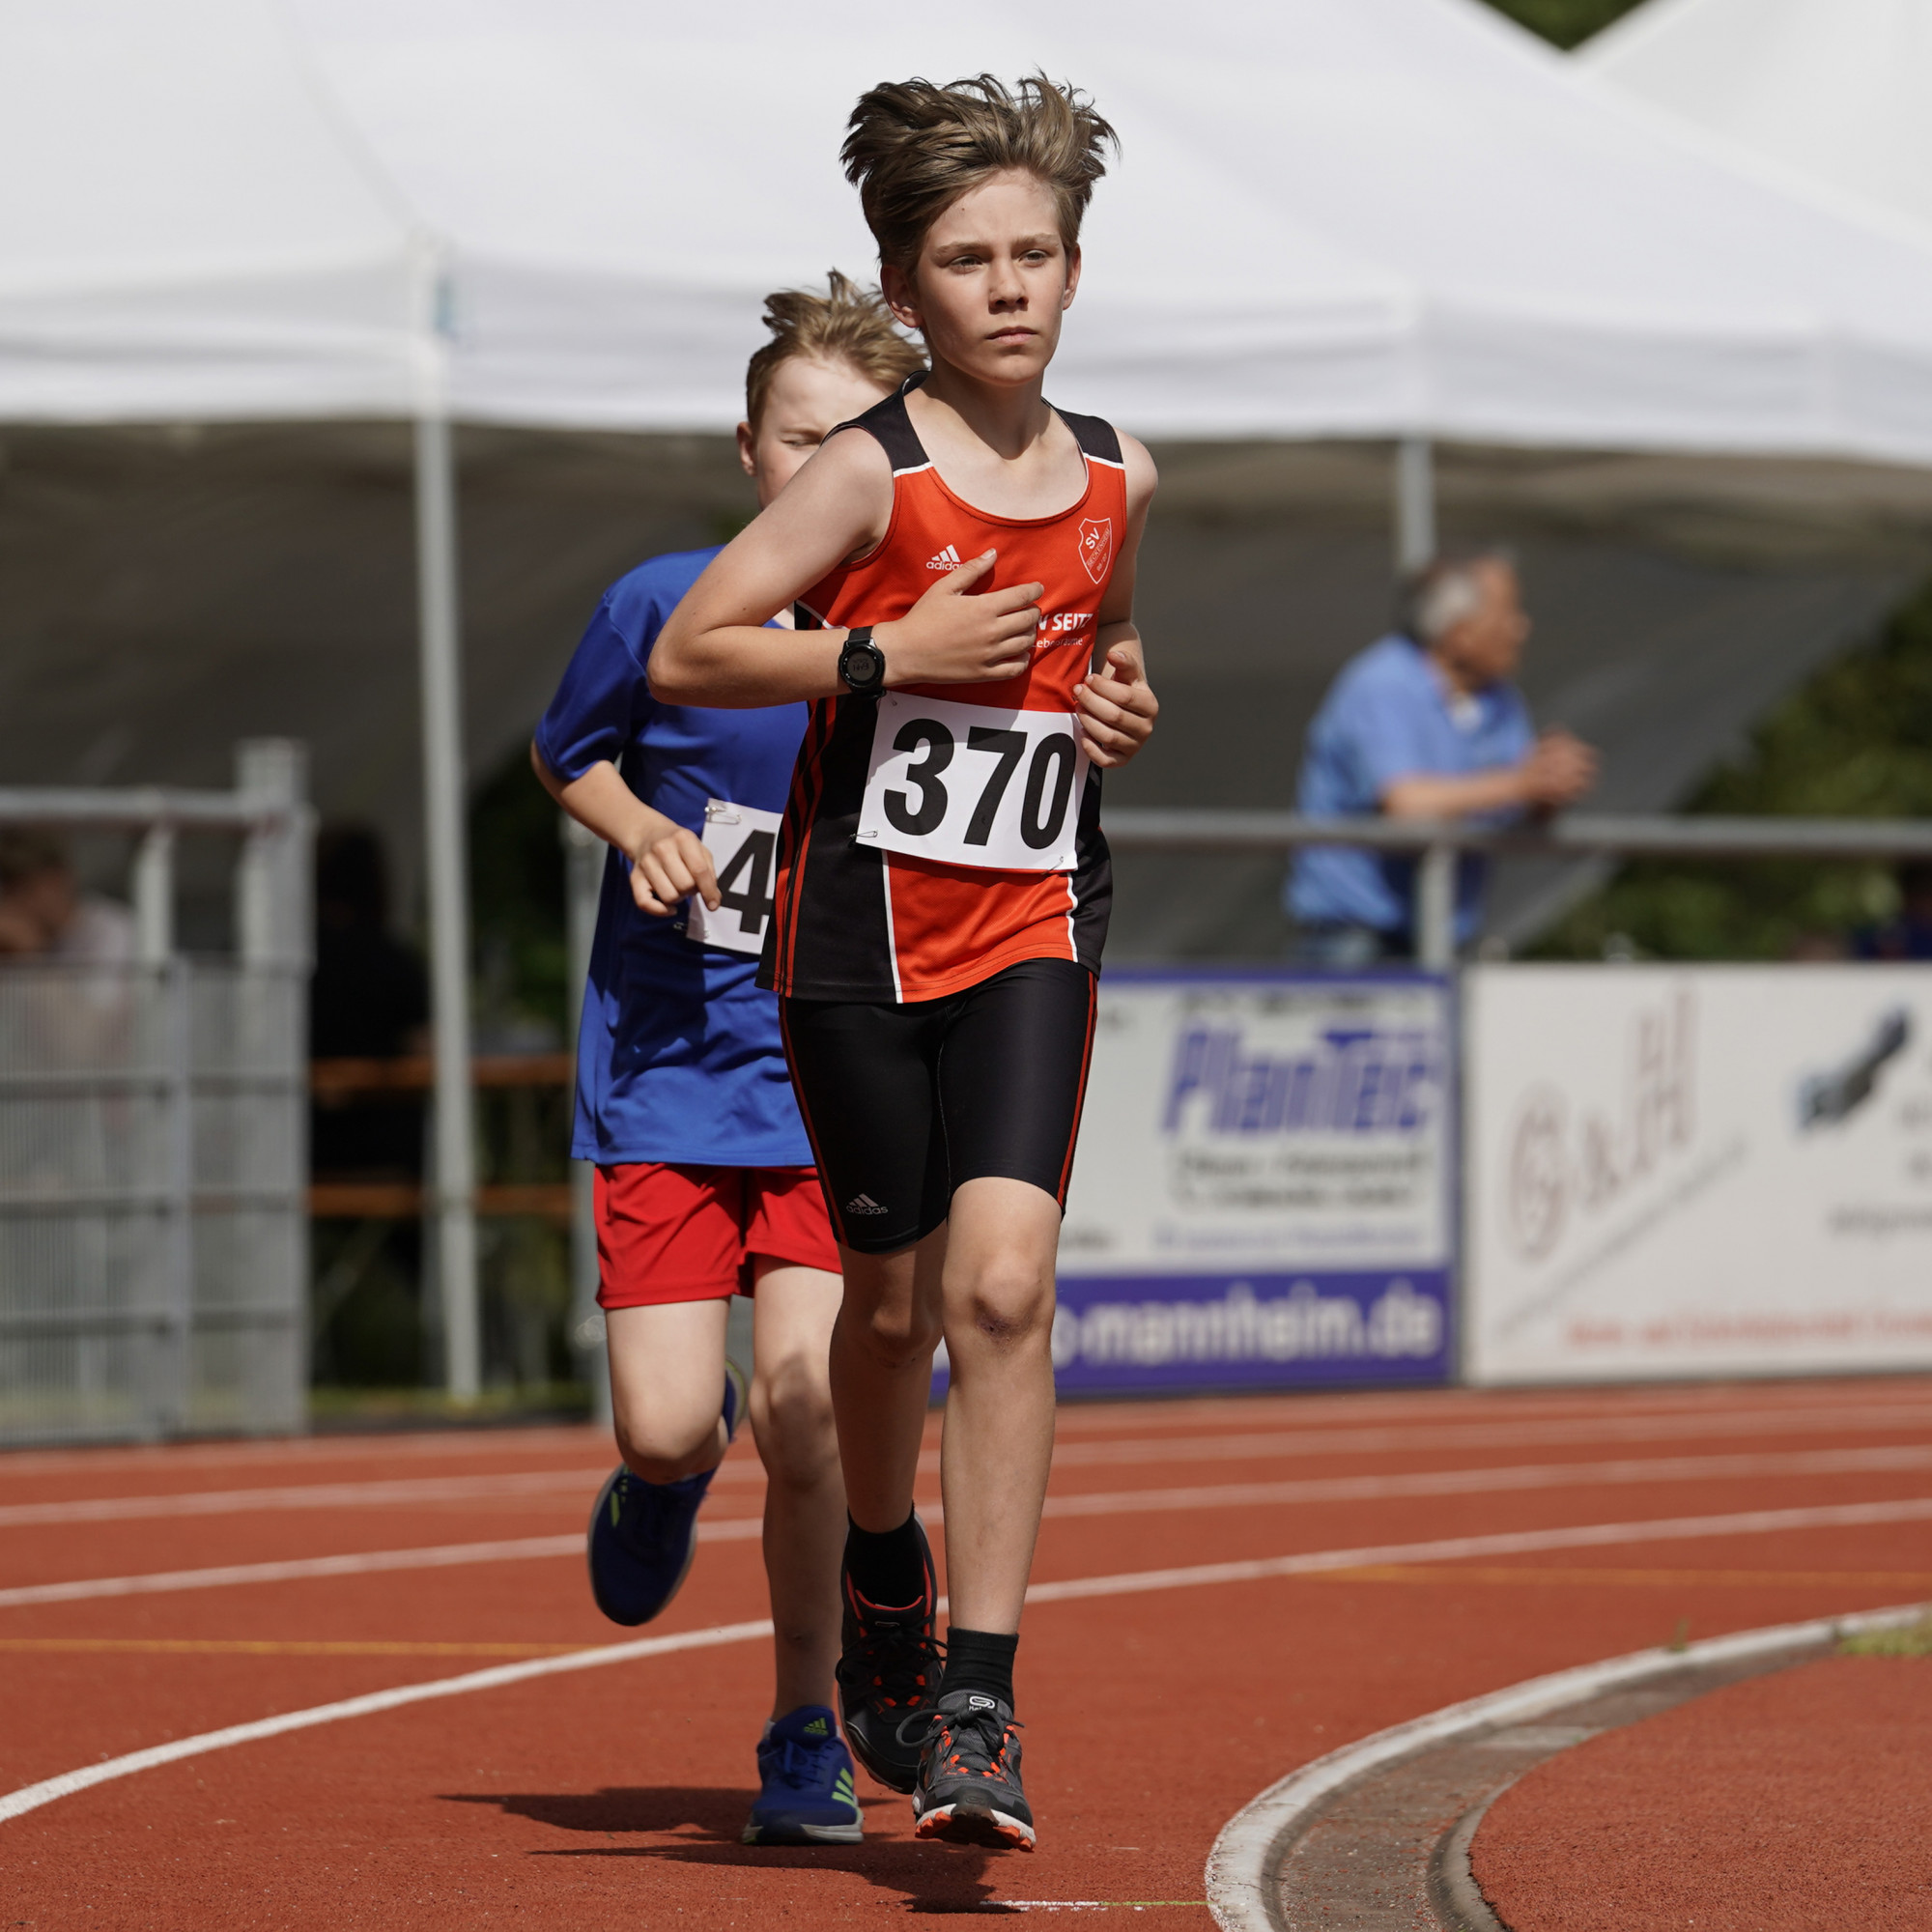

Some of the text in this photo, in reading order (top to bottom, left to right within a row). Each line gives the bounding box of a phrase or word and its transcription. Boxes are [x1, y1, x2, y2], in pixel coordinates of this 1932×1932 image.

[1085, 526, 1100, 550] SV
[925, 561, 964, 571] adida
[883, 718, 1077, 850] 370
[845, 1205, 889, 1215] adidas
